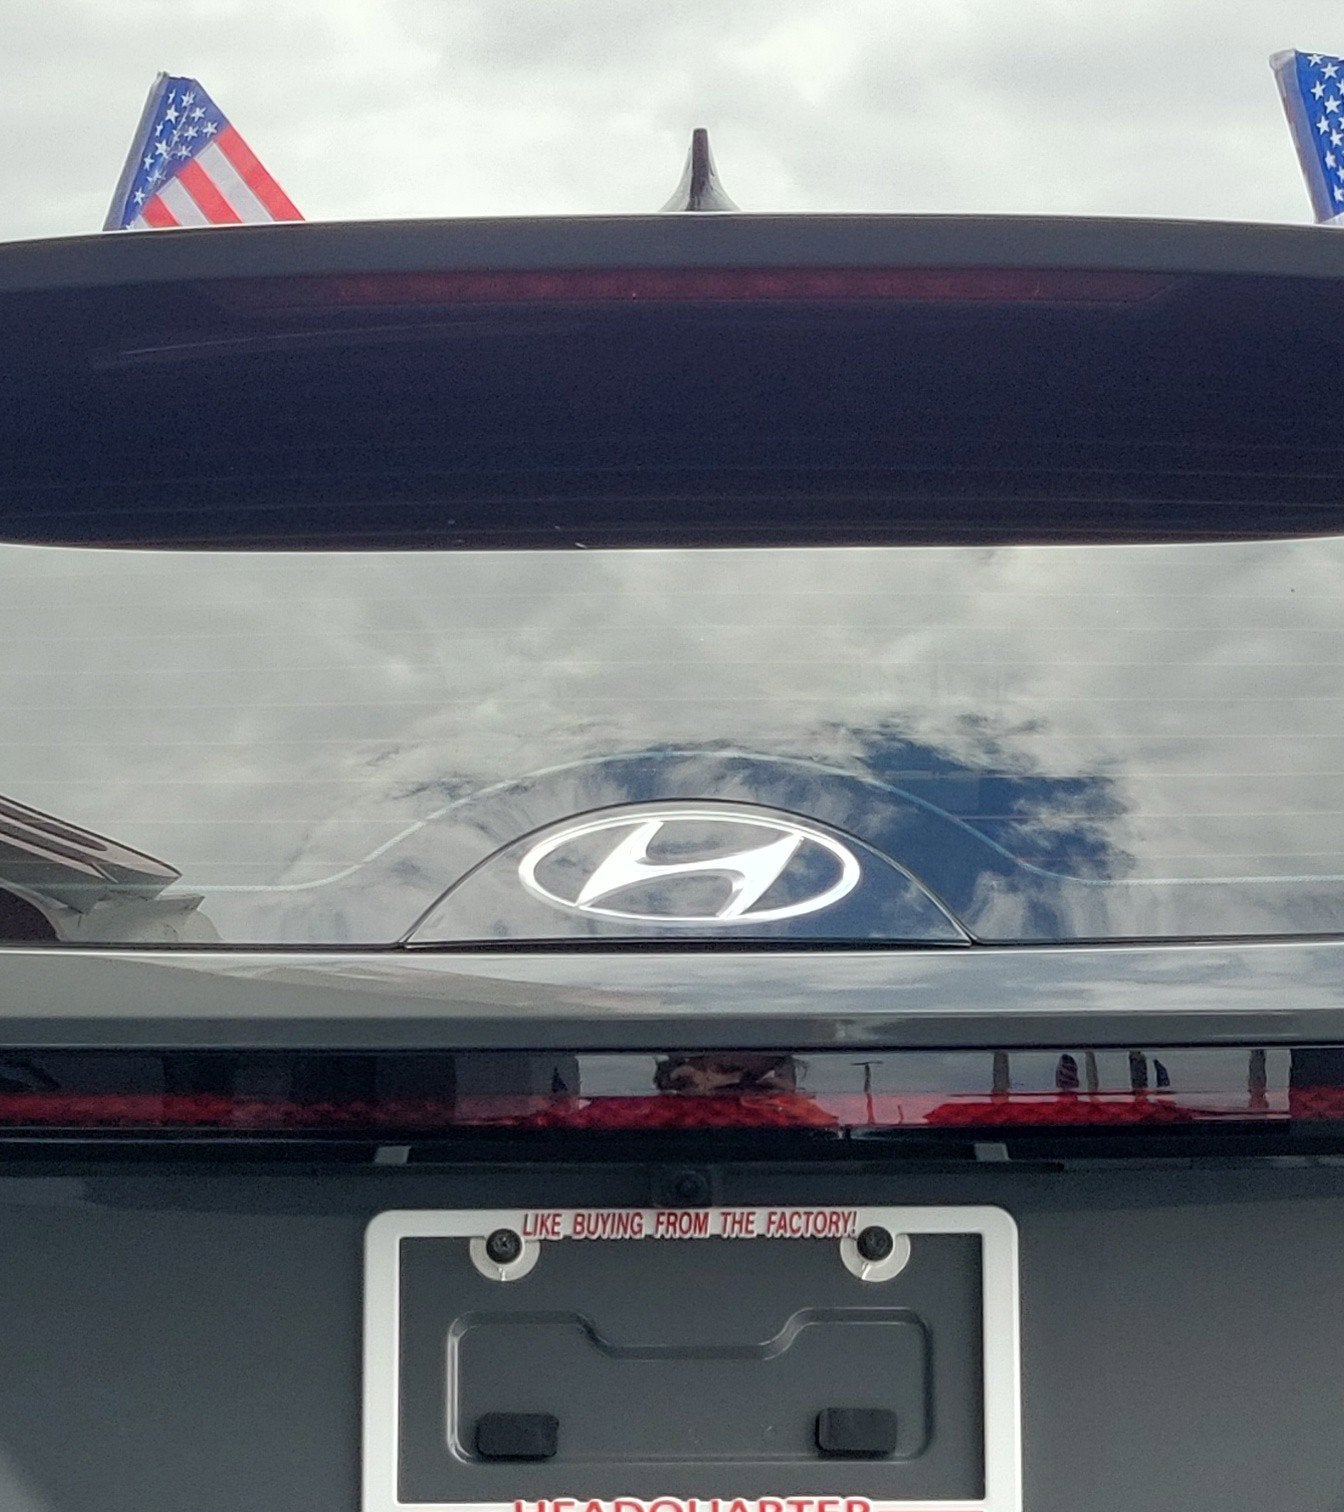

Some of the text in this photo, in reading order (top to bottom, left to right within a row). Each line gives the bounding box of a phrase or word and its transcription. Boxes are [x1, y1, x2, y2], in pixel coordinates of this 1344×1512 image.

[522, 1210, 859, 1238] LIKE BUYING FROM THE FACTORY!
